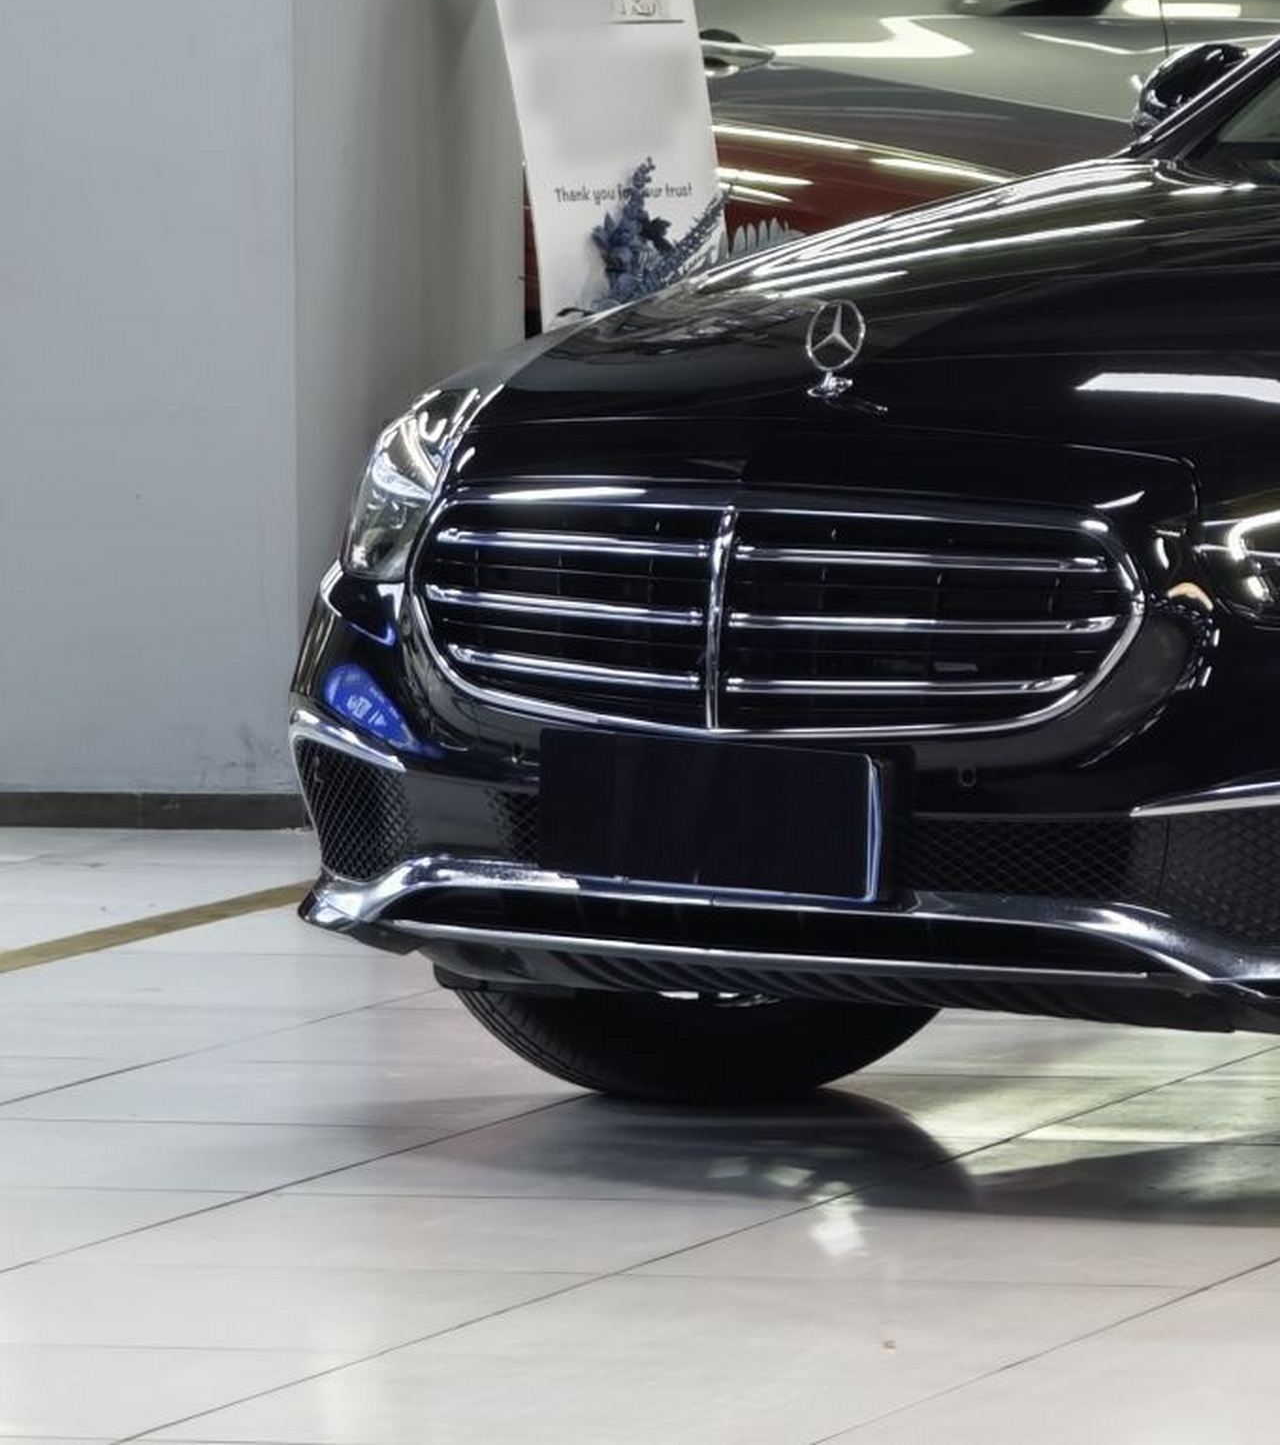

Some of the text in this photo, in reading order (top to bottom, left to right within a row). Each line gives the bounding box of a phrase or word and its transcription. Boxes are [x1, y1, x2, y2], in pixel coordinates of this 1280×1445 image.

[554, 184, 590, 203] Thank
[592, 188, 615, 205] you
[665, 182, 693, 198] trust
